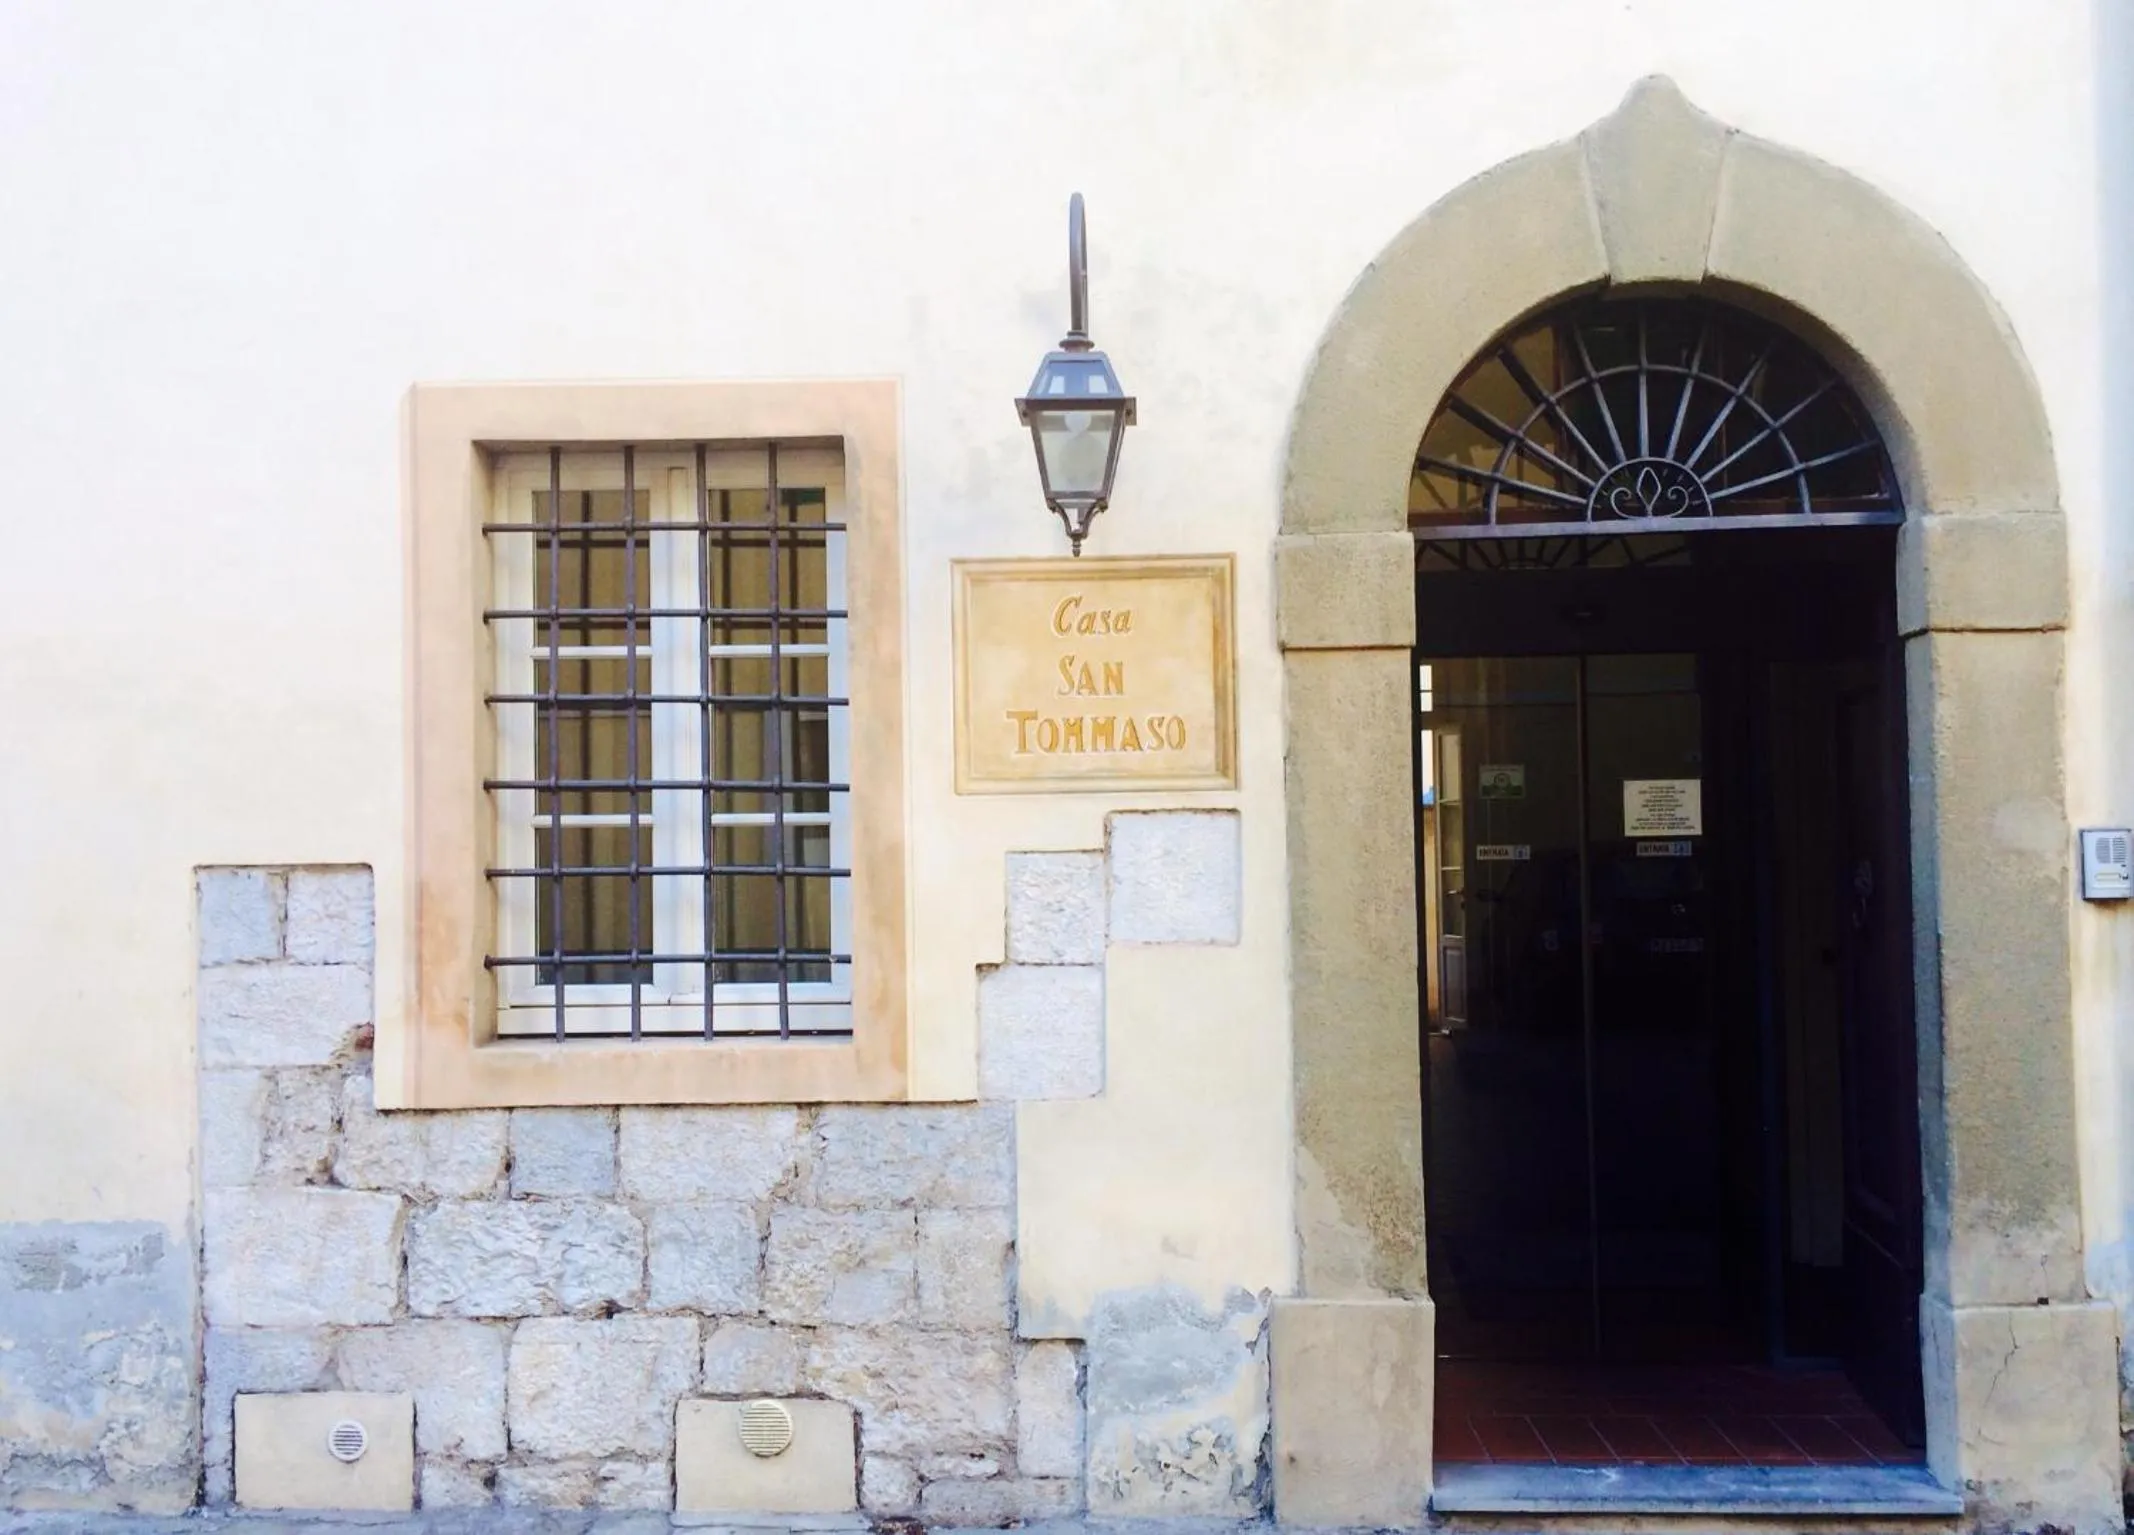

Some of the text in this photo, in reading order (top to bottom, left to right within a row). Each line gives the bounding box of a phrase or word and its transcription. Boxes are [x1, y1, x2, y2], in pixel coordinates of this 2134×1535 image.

[1053, 595, 1133, 636] Casa
[1057, 655, 1125, 696] SAN
[1006, 710, 1187, 754] TOMMASO
